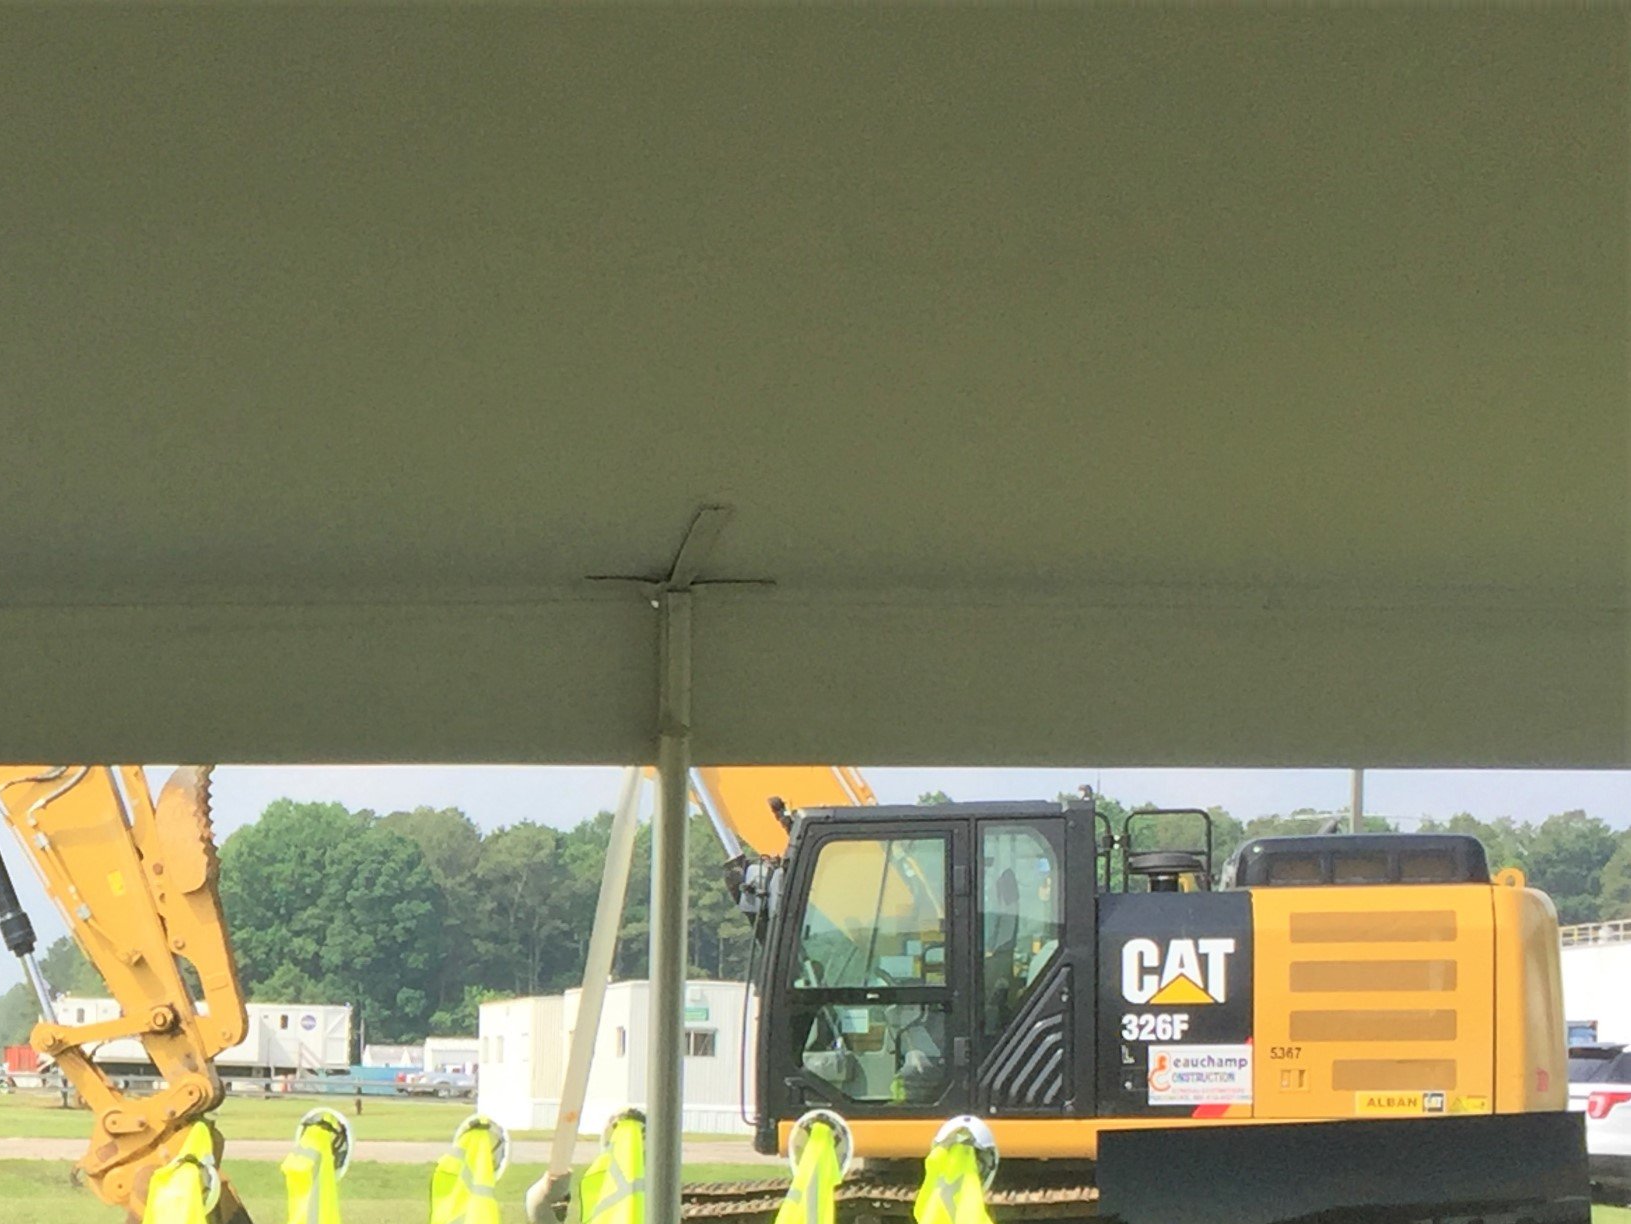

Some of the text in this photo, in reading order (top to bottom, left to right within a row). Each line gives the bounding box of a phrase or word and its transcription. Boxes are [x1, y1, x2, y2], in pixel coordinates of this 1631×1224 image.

[1122, 938, 1235, 1004] CAT
[1121, 1013, 1189, 1041] 326F
[1270, 1047, 1301, 1059] 5367
[1367, 1097, 1417, 1107] ALBAN
